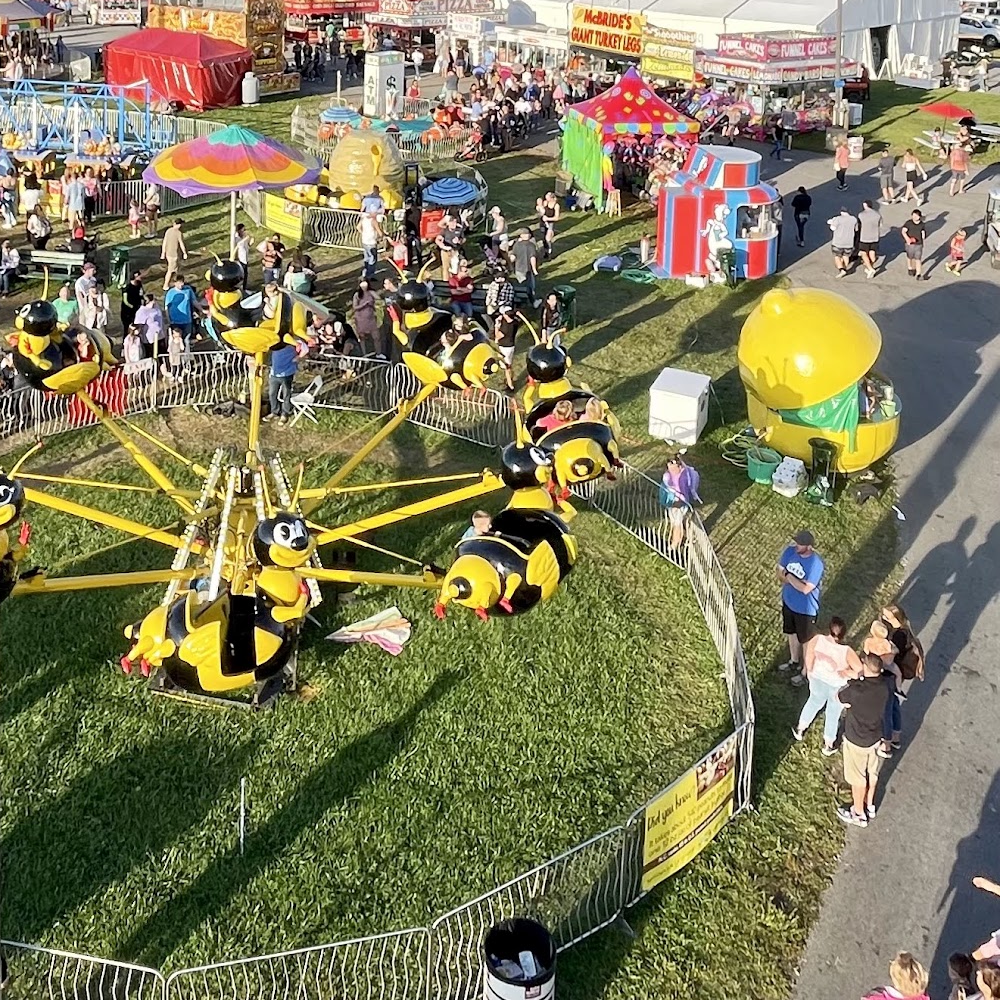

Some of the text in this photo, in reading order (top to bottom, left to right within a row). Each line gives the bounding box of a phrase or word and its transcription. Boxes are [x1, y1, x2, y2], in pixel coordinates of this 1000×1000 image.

[583, 8, 632, 31] McBRIDE'S
[571, 26, 642, 54] GIANT TURKEY LEGS
[718, 40, 765, 57] FUNNEL CAKES
[781, 42, 828, 58] FUNNEL CAKES
[367, 75, 375, 106] ATM
[647, 810, 660, 831] Did
[662, 804, 674, 825] you
